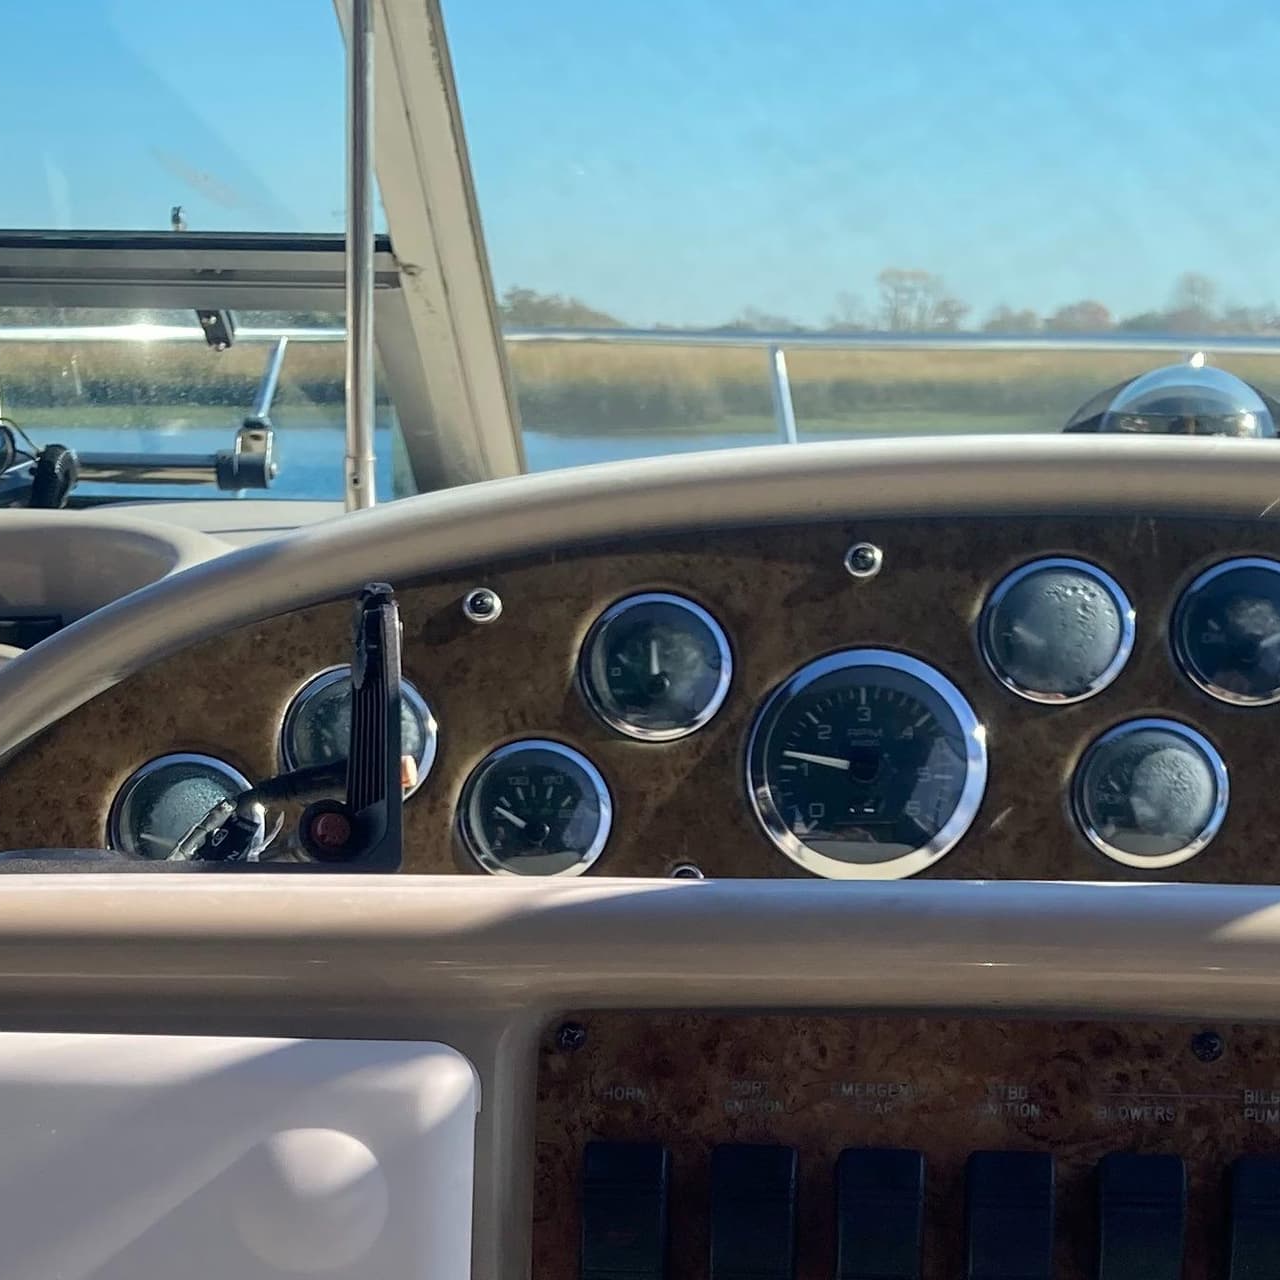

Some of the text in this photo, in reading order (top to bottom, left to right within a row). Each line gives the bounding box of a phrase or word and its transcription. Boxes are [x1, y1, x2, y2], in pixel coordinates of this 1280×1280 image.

[858, 707, 871, 722] 3
[818, 725, 832, 740] 2
[603, 1087, 646, 1102] HORN
[731, 1080, 769, 1096] PORT
[1096, 1105, 1177, 1122] BLOWERS
